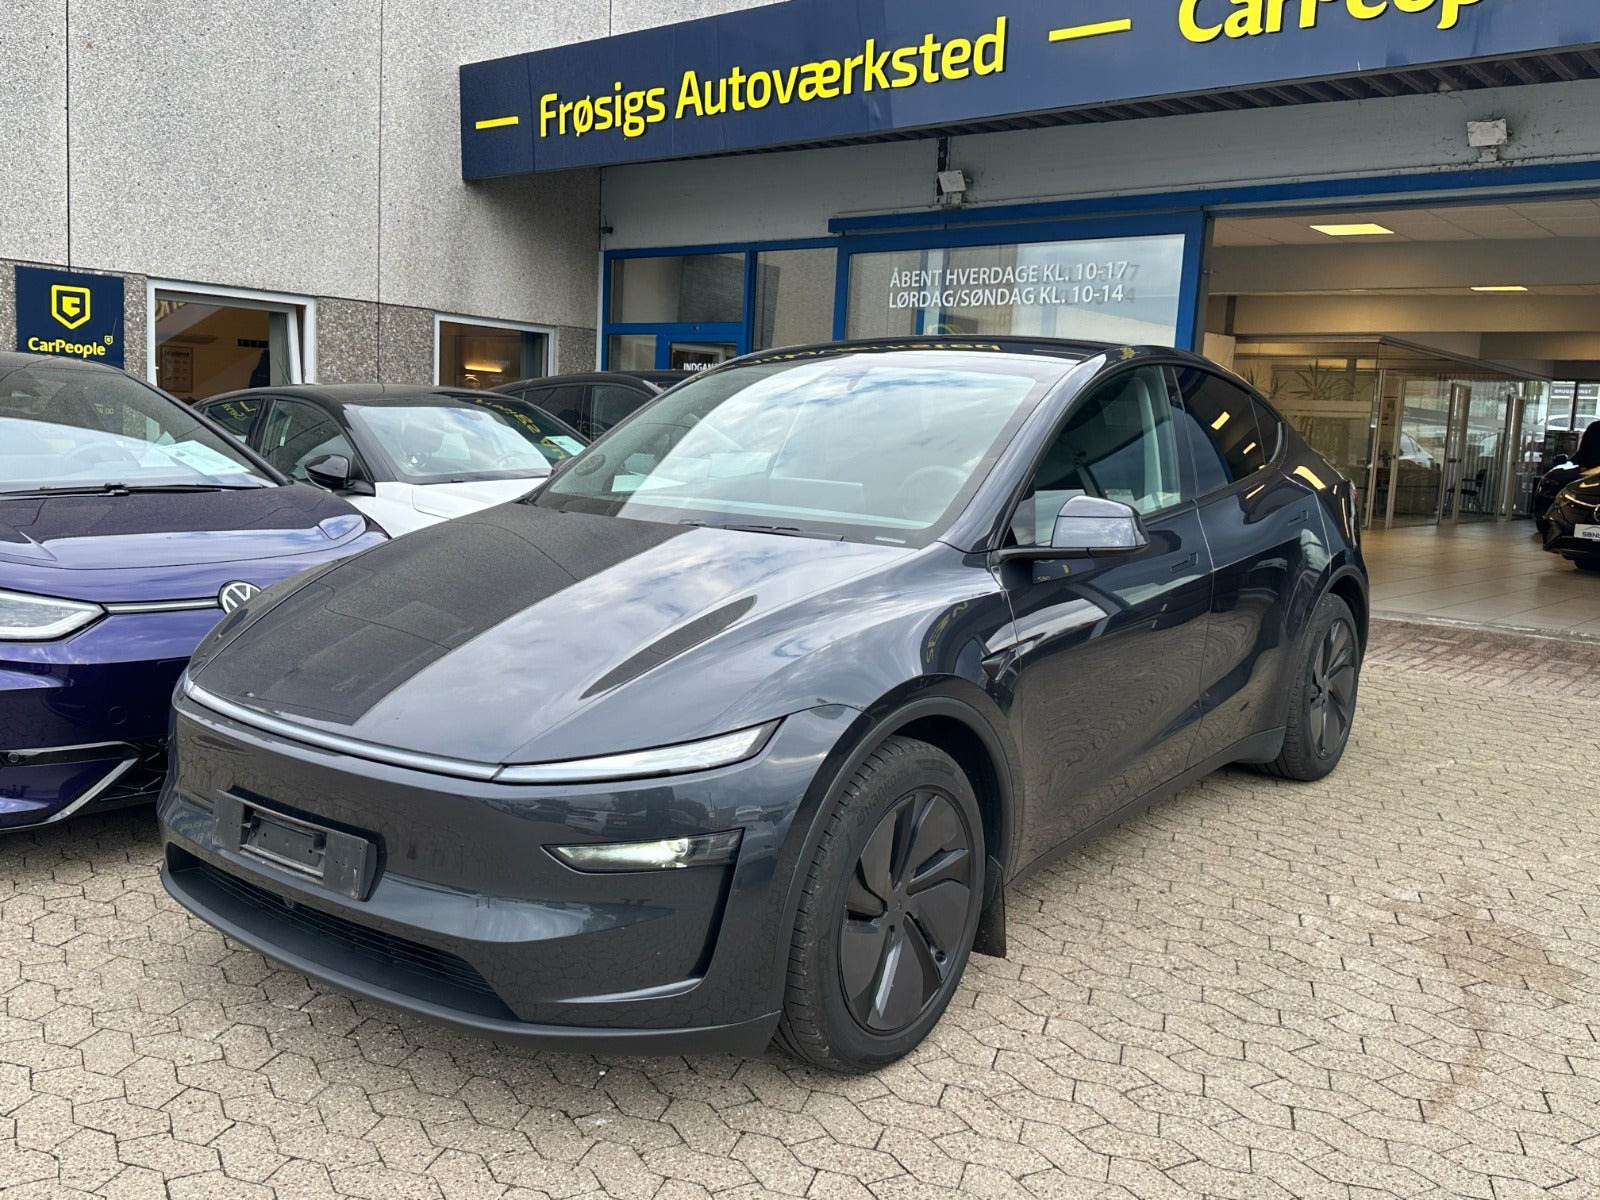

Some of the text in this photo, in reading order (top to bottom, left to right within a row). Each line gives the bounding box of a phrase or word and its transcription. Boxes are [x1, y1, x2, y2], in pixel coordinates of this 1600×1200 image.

[540, 16, 1008, 138] Frøsigs Autoværksted
[890, 260, 1128, 288] ÅBENT HVERDAGE KL. 10-17
[889, 283, 1124, 309] LØRDAG/SØNDAG KL. 10-14
[28, 337, 106, 358] CarPeople
[683, 362, 720, 372] INDGAN
